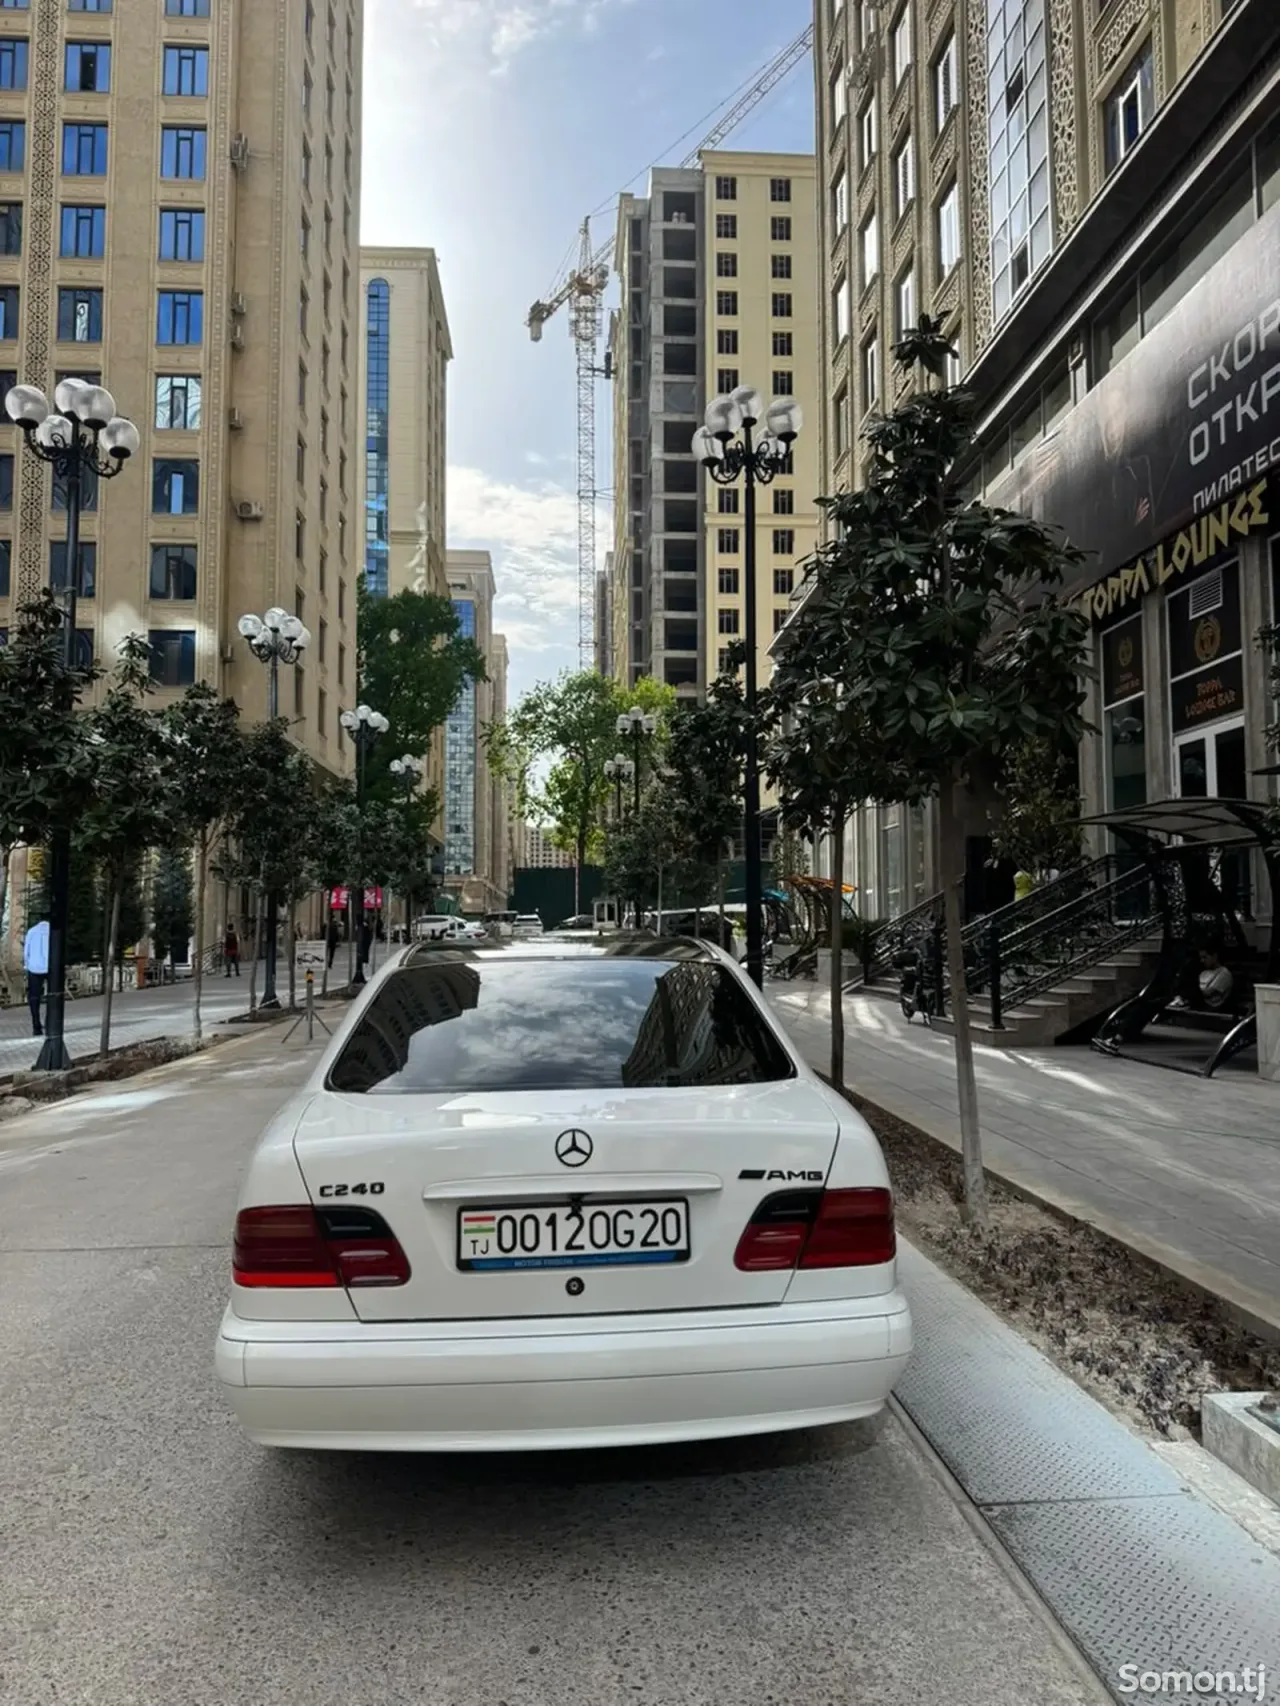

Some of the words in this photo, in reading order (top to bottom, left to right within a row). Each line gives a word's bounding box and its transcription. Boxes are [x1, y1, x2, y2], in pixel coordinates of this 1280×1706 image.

[1082, 558, 1150, 622] TOPPA
[1157, 477, 1269, 586] LOUNGE
[767, 1170, 823, 1181] AMG
[319, 1182, 385, 1198] C240
[471, 1239, 489, 1255] TJ
